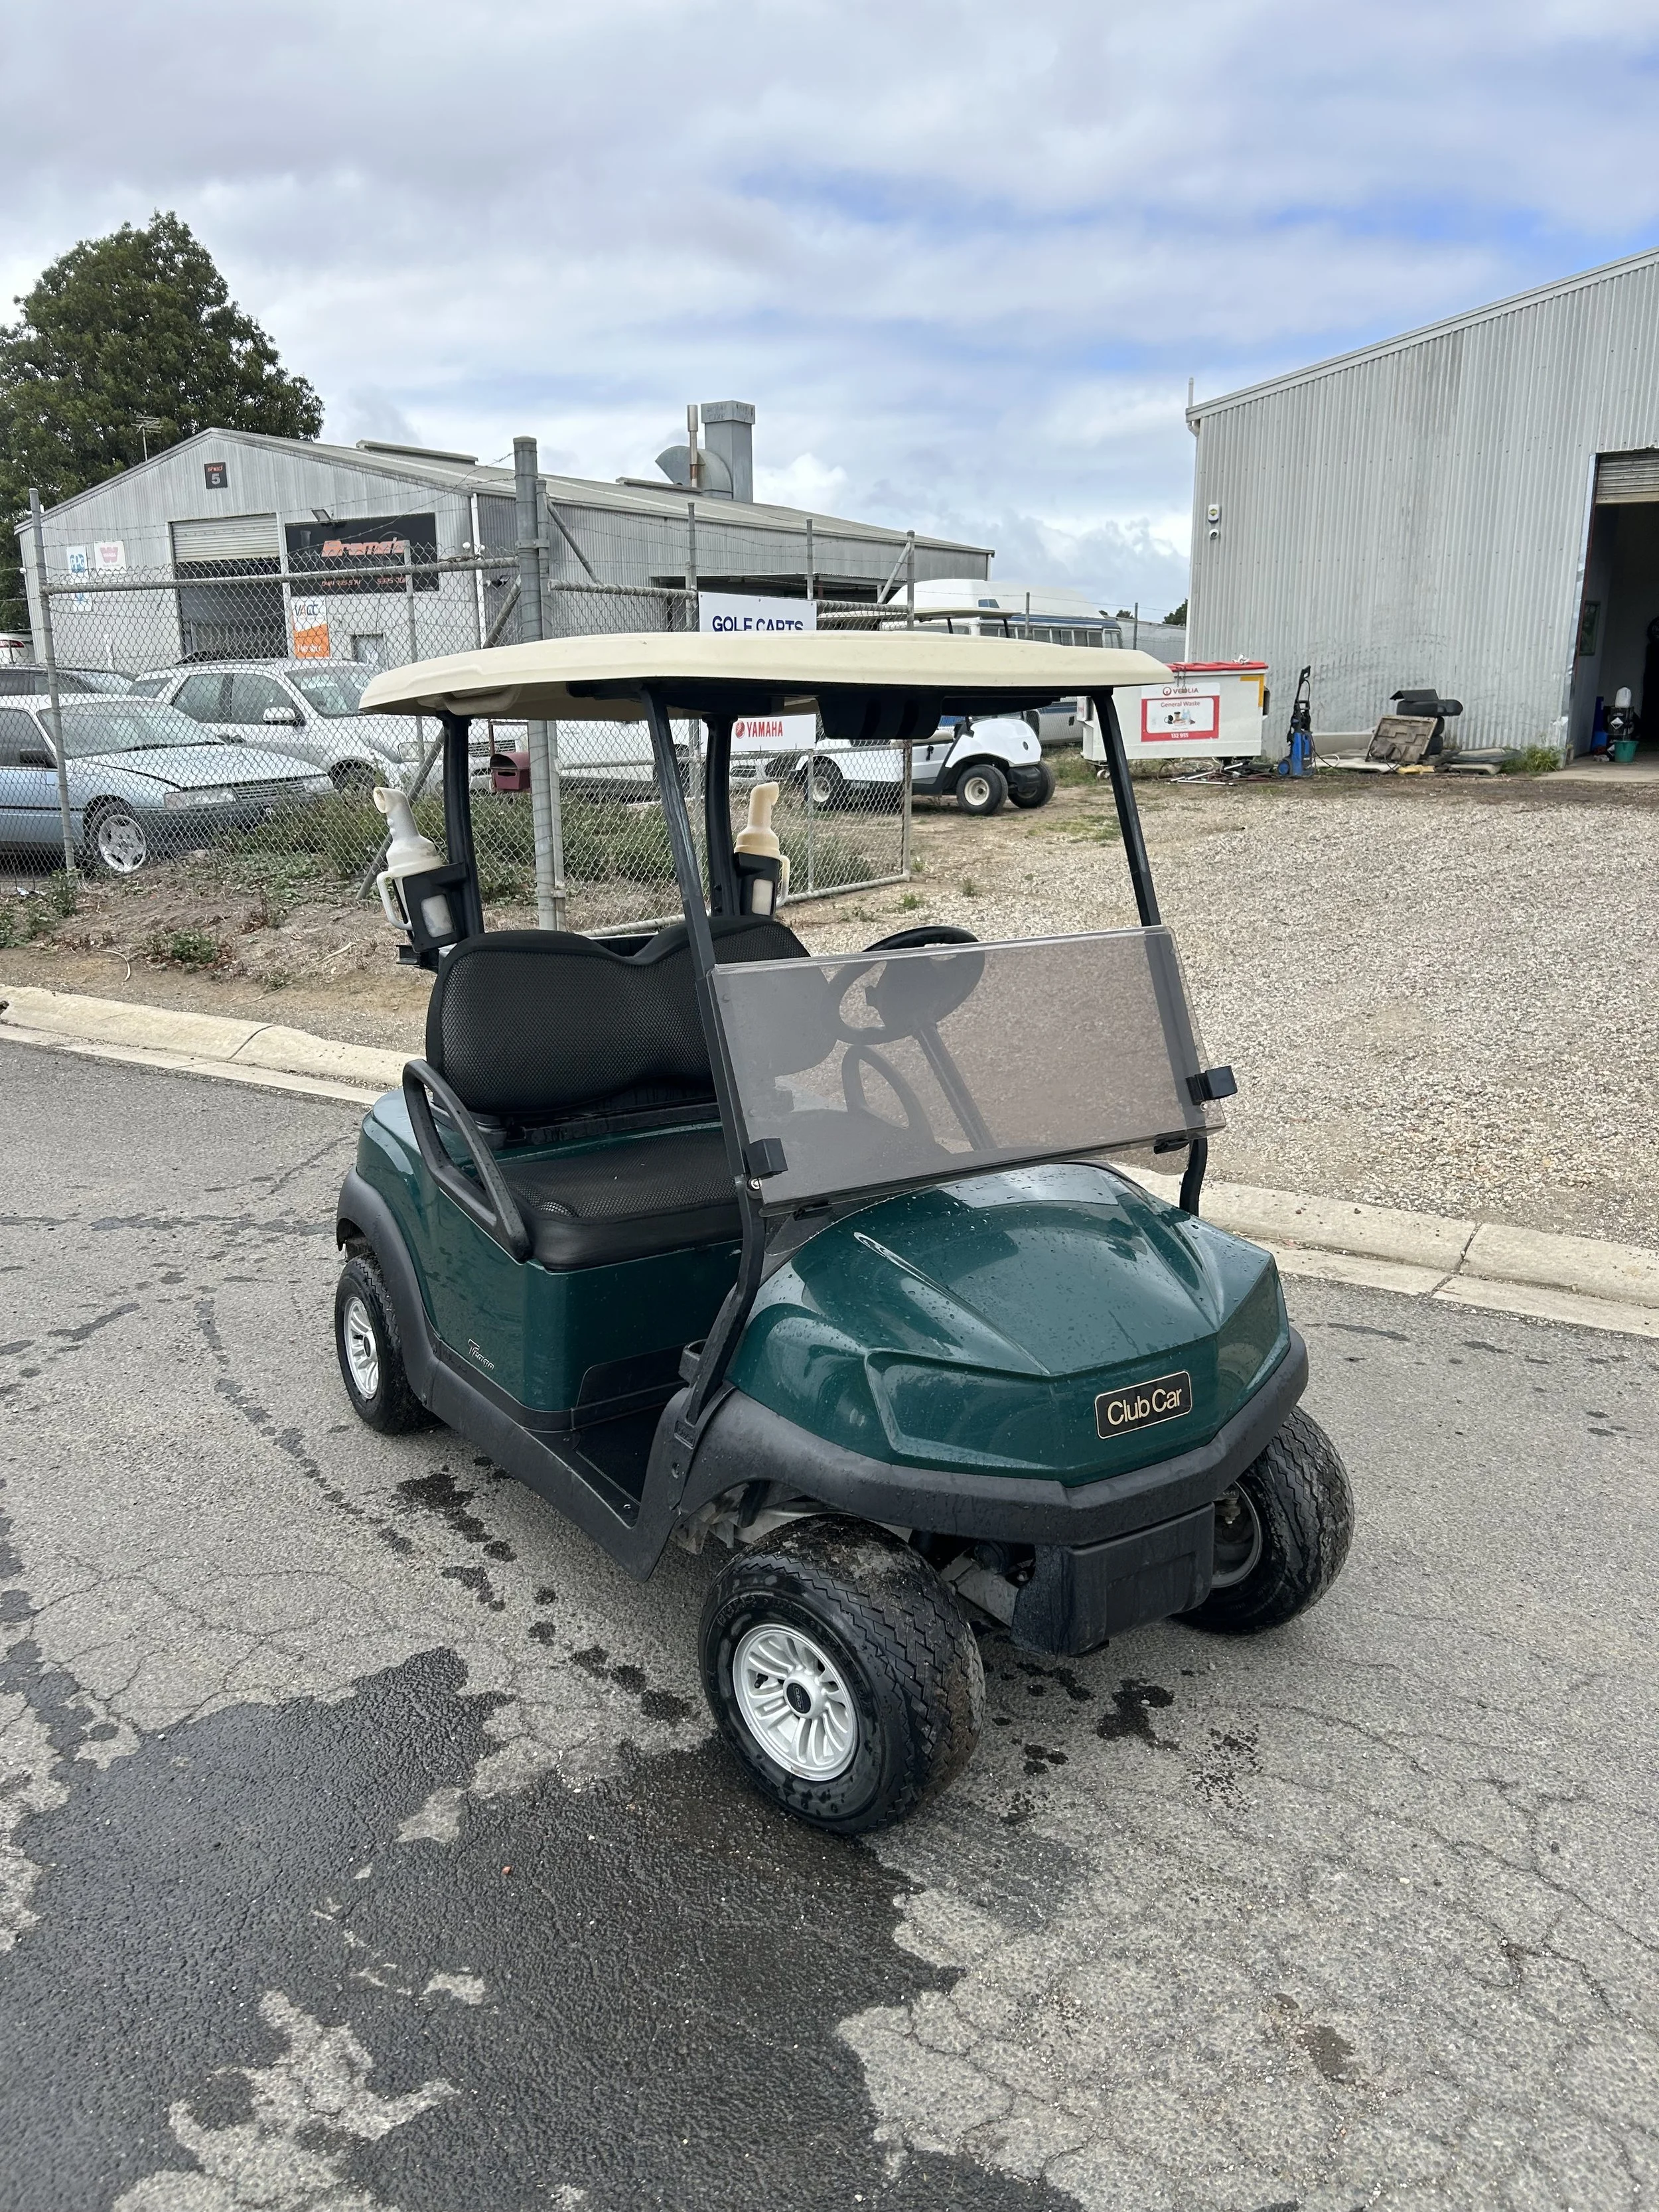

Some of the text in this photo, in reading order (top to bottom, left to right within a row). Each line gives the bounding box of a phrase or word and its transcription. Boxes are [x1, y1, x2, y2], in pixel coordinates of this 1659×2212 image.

[211, 473, 221, 484] 5
[295, 604, 319, 616] VACC
[712, 615, 804, 632] GOLF CARTS
[747, 721, 783, 737] YAMAHA
[467, 1339, 494, 1370] Tempo
[1108, 1388, 1182, 1426] Club Car
